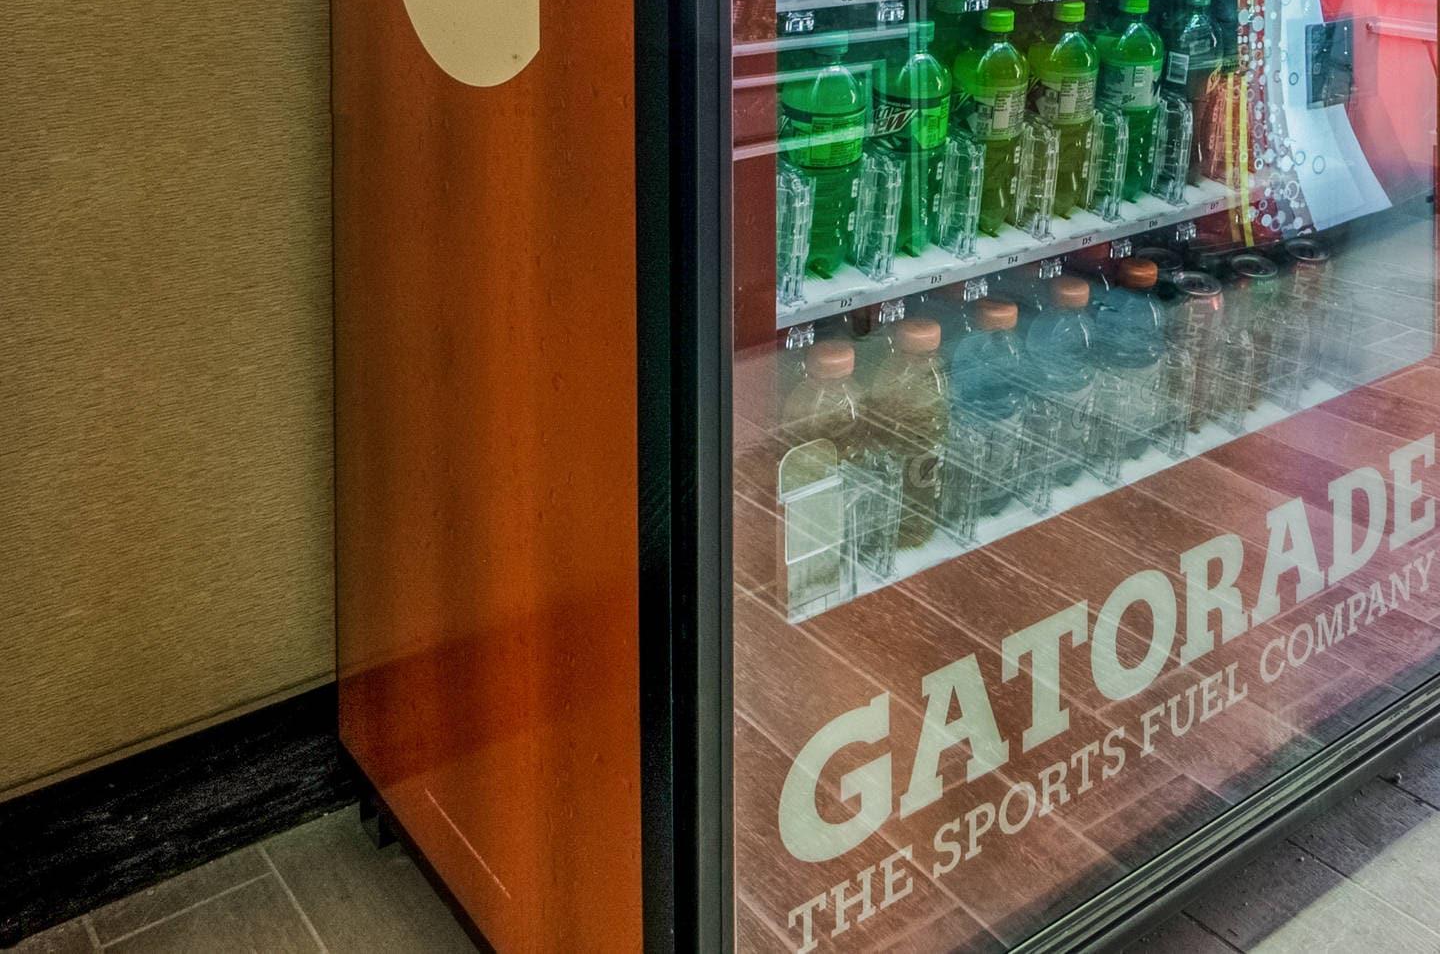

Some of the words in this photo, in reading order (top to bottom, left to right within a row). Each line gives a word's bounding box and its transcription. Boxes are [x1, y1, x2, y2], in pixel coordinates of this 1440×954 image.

[1082, 236, 1092, 245] D5
[1007, 256, 1018, 264] D4
[930, 275, 942, 284] D3
[840, 298, 853, 308] D2
[777, 433, 1436, 863] GATORADE
[787, 847, 915, 954] THE
[932, 728, 1126, 879] SPORTS
[1139, 662, 1249, 757] FUEL
[1259, 550, 1436, 684] COMPANY
